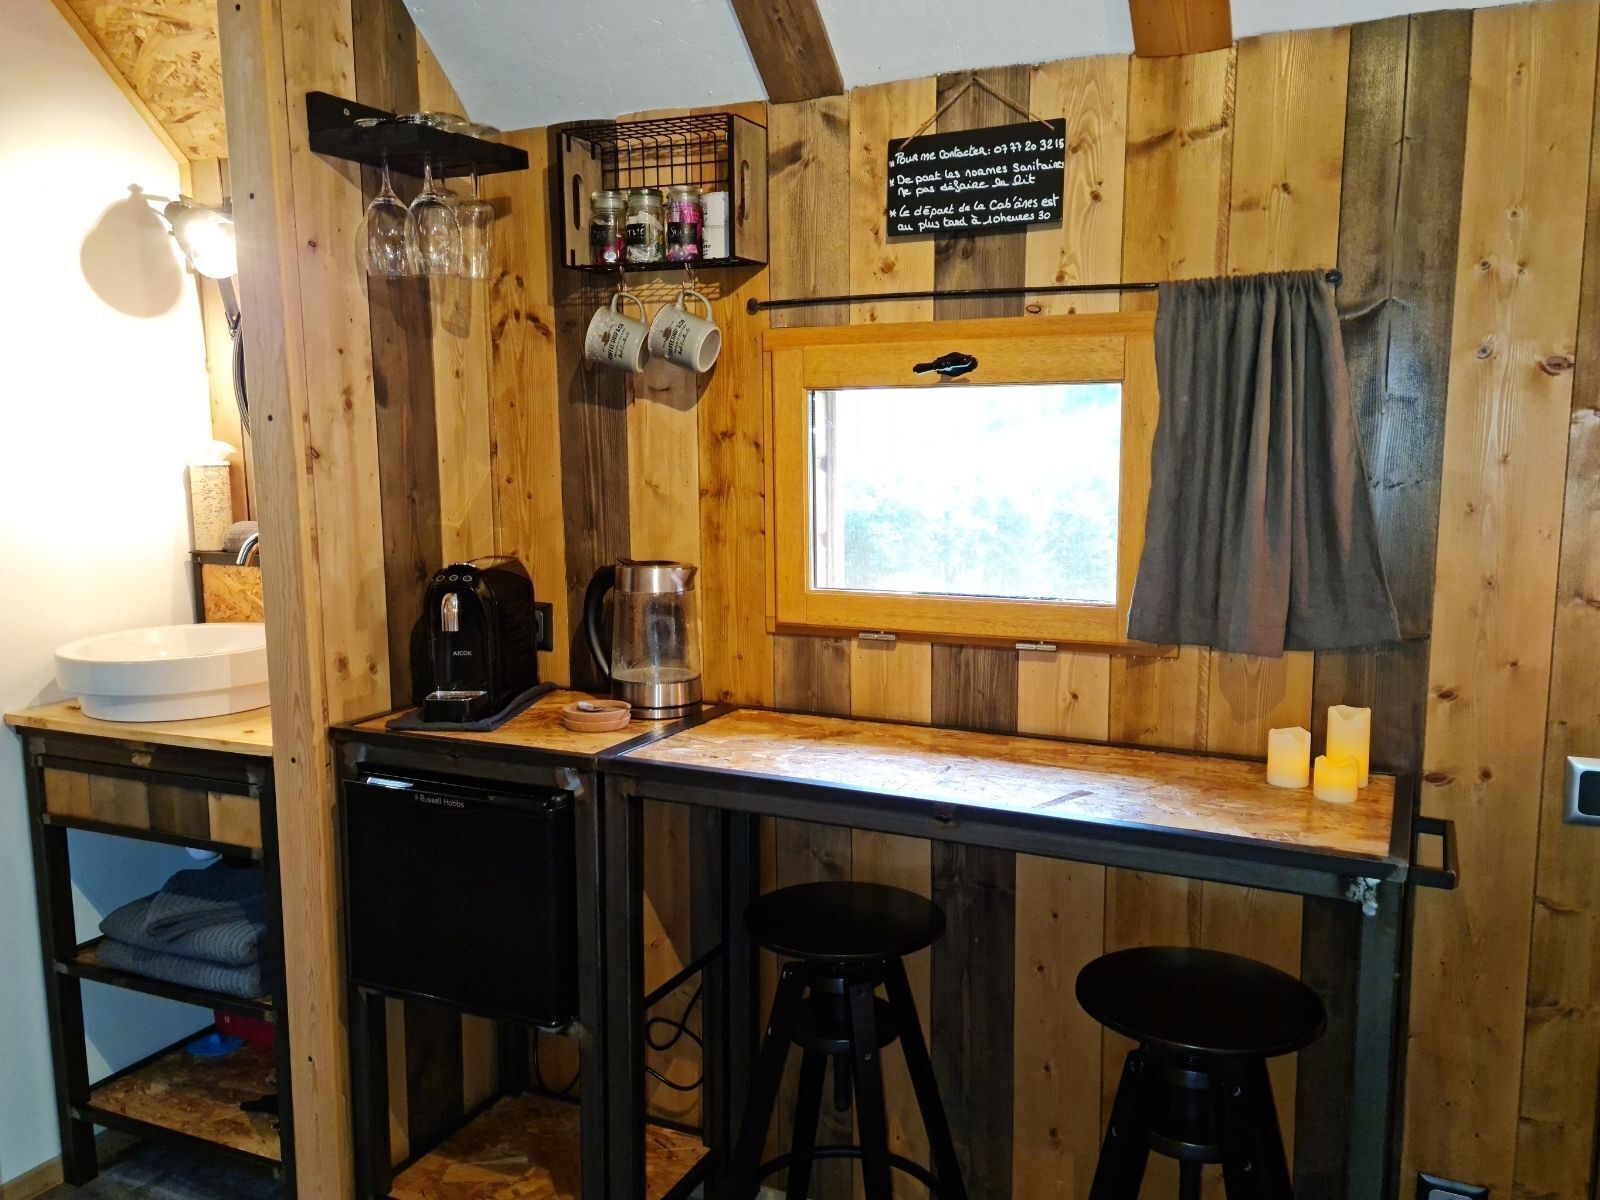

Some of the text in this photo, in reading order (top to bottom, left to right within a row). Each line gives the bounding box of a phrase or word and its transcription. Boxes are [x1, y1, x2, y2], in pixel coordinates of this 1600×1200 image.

[993, 143, 1007, 154] 07
[1009, 141, 1022, 153] 77
[1024, 140, 1037, 151] 20
[1039, 138, 1053, 151] 32
[1055, 138, 1064, 149] 15
[896, 174, 914, 185] De
[915, 185, 935, 197] pas
[991, 177, 1010, 188] le
[1011, 173, 1036, 186] lit
[913, 203, 955, 219] départ
[958, 202, 971, 212] de
[1041, 193, 1060, 207] est
[897, 223, 914, 231] au
[918, 218, 940, 233] plus
[943, 216, 969, 227] tard
[970, 214, 982, 225] à
[1038, 210, 1051, 220] 30
[419, 794, 465, 808] Russell Hobbs
